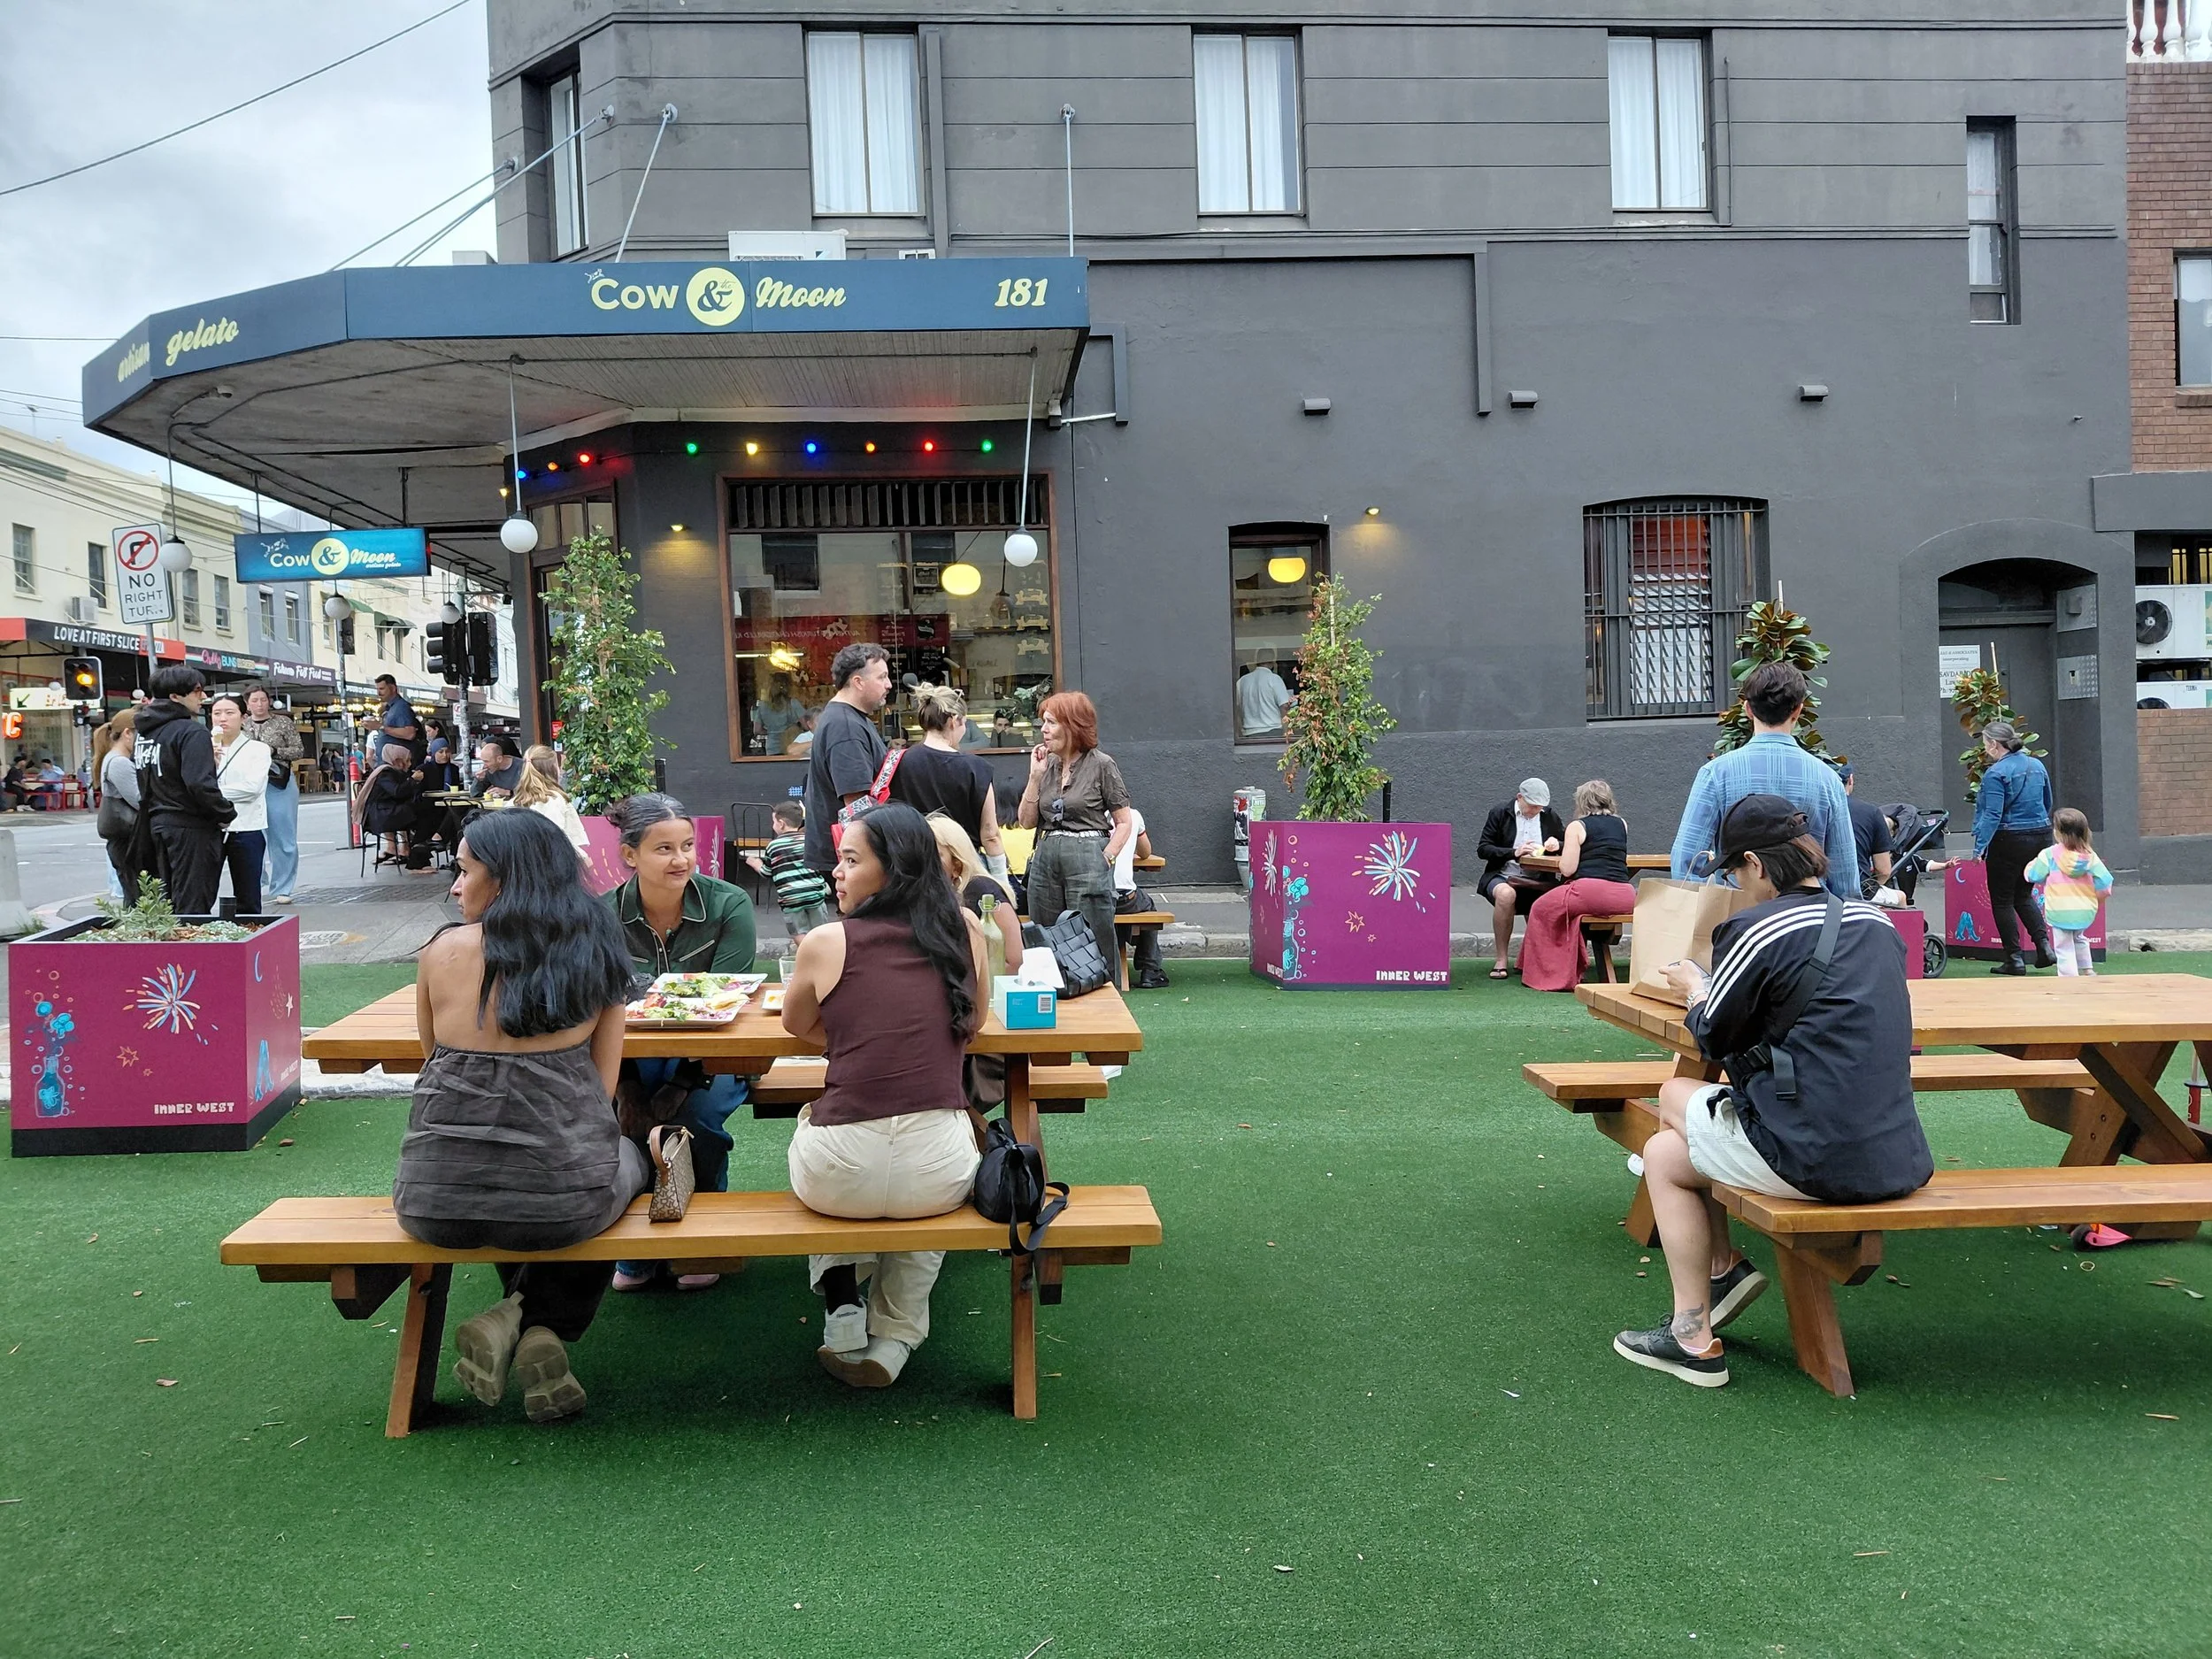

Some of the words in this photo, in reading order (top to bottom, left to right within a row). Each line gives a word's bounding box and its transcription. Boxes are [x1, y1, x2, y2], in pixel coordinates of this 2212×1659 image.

[591, 278, 680, 310] Cow
[756, 277, 847, 308] Moon
[994, 278, 1048, 307] 181
[165, 317, 240, 366] gelato
[269, 552, 310, 568] Cow
[350, 549, 396, 565] Moon
[128, 572, 156, 589] NO
[124, 589, 164, 604] RIGHT
[54, 626, 79, 646] LOVE
[79, 629, 93, 644] AT
[91, 633, 117, 648] FIRST
[117, 635, 141, 651] SLICE
[1376, 970, 1410, 981] INNER
[1414, 971, 1448, 981] WEST
[154, 1103, 193, 1115] INNER
[196, 1102, 235, 1113] WEST
